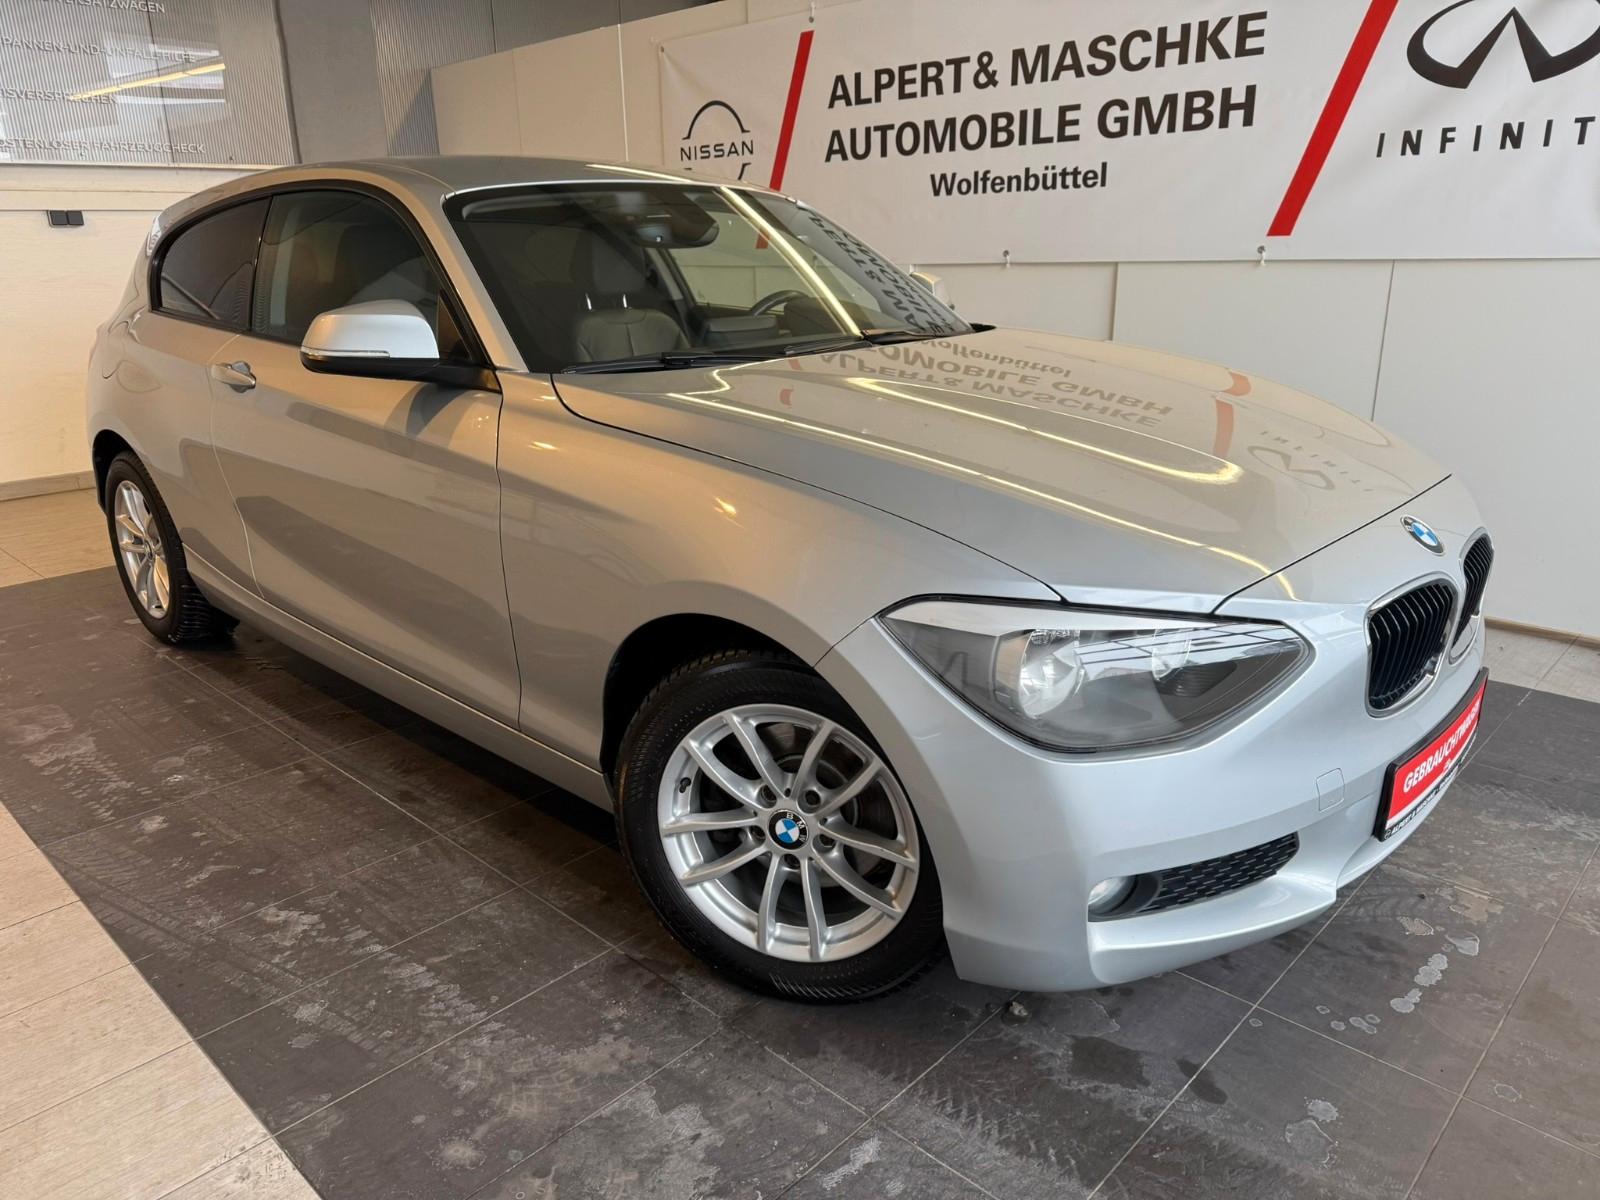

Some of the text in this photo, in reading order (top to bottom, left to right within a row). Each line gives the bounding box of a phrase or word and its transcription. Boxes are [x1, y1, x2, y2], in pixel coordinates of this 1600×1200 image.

[1010, 10, 1269, 88] MASCHKE
[680, 139, 755, 162] NISSAN
[824, 84, 1258, 163] AUTOMOBILE GMBH
[929, 161, 1109, 198] Wolfenbüttel
